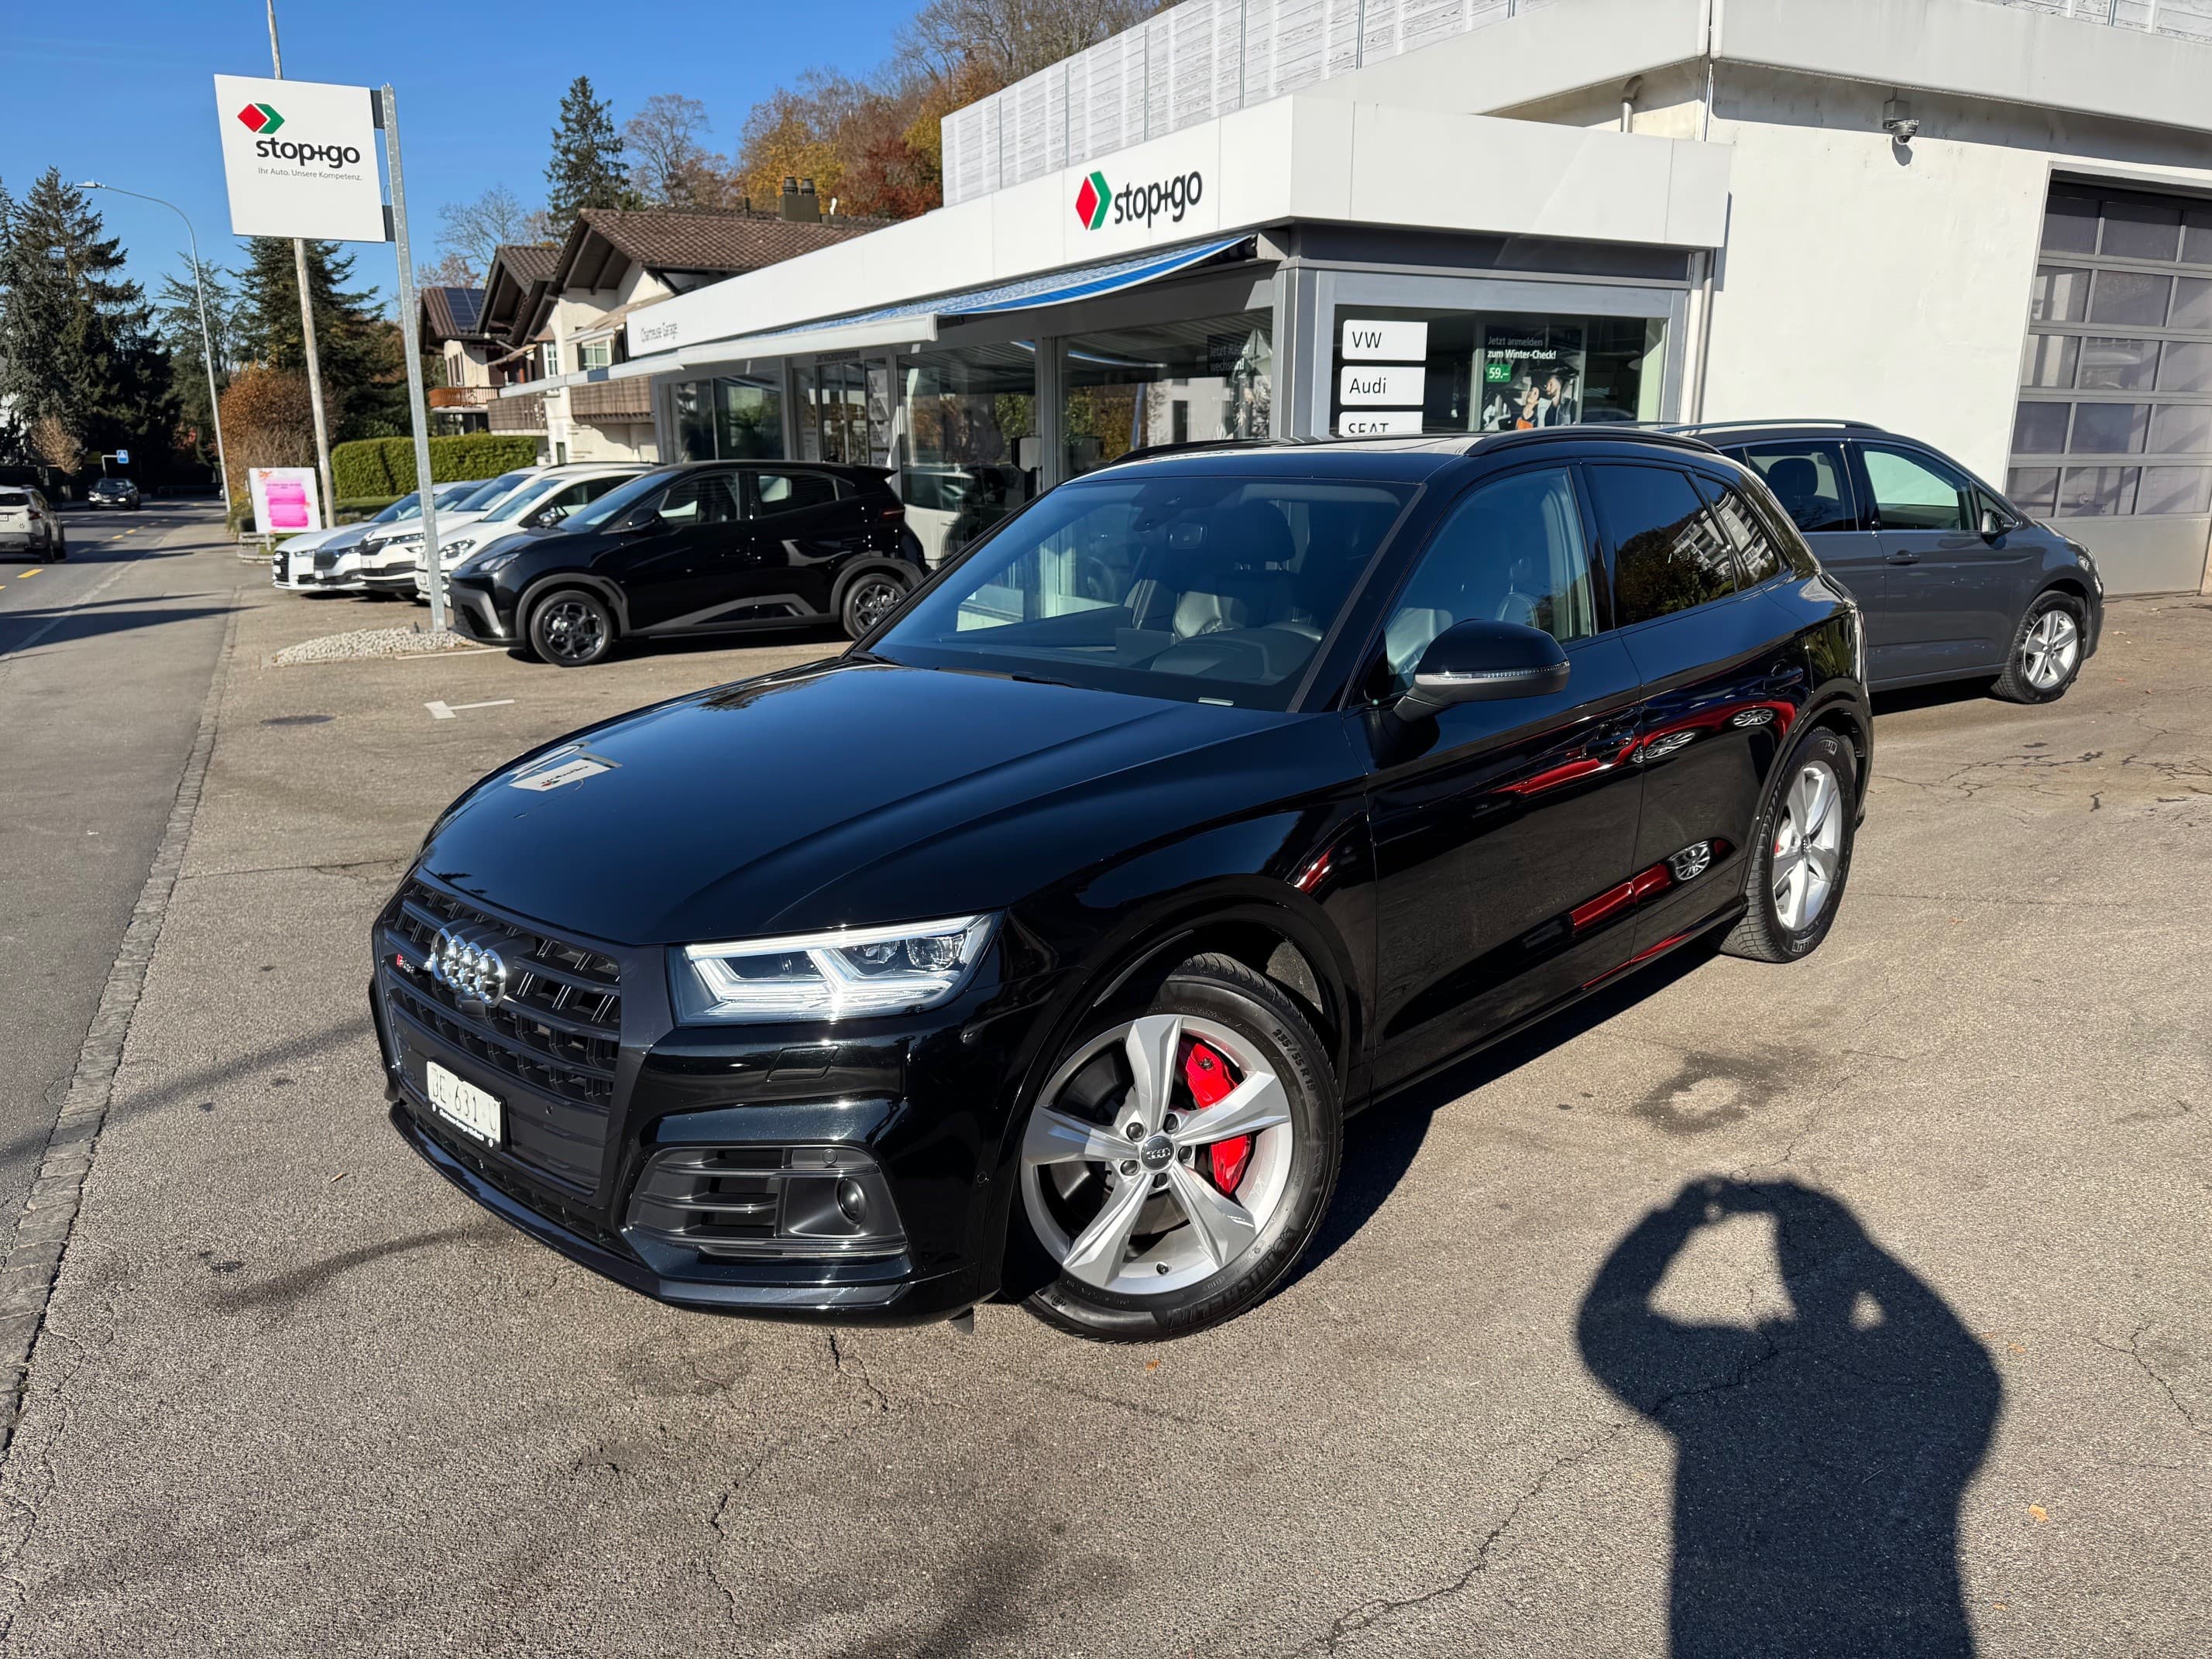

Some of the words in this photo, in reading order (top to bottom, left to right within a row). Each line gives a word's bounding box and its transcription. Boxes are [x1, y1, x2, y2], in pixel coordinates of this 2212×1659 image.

[256, 137, 361, 169] stop+go
[291, 170, 318, 178] Unsere
[319, 171, 362, 181] Kompetenz.
[1115, 170, 1203, 228] stop+go
[1352, 331, 1382, 349] VW
[1488, 336, 1506, 346] Jetzt
[1507, 336, 1543, 347] anmelden
[1487, 350, 1504, 359] zum
[1505, 349, 1557, 360] Winter-Check!
[1349, 376, 1387, 394] Audi
